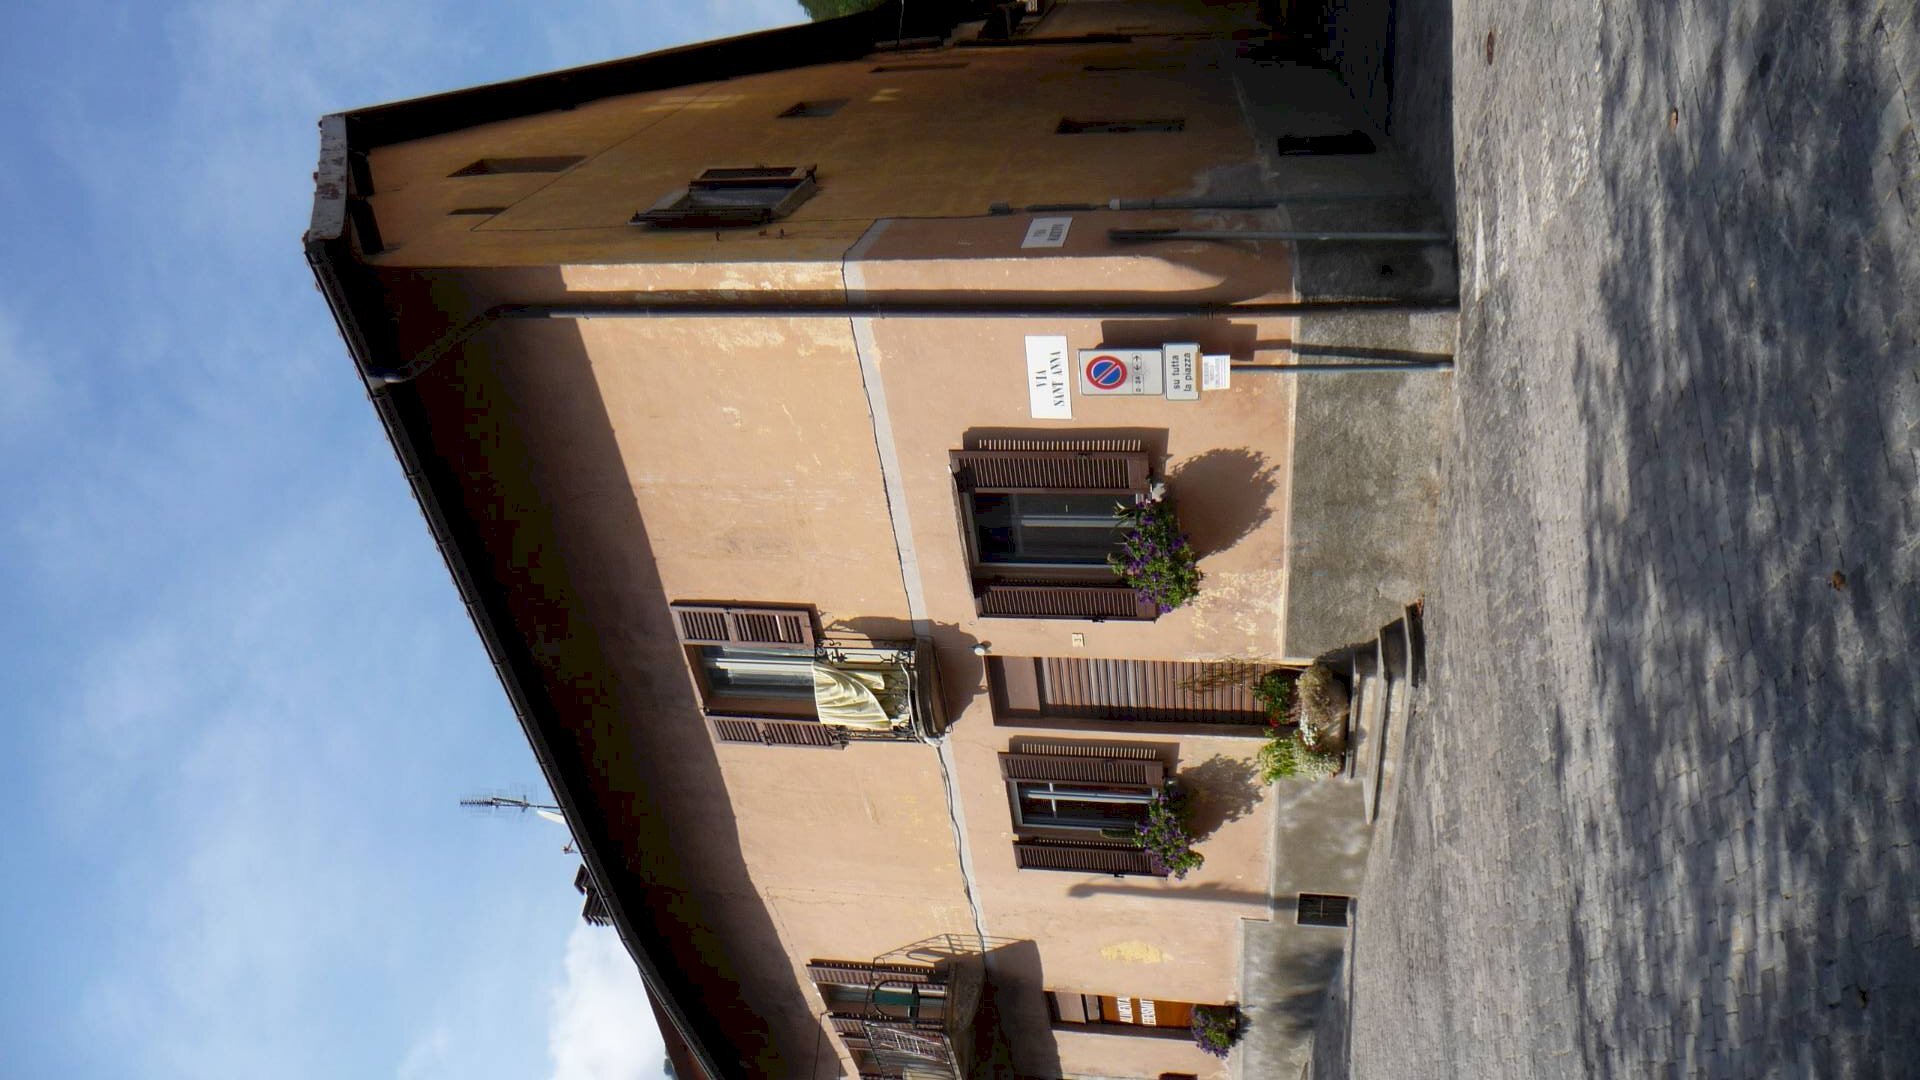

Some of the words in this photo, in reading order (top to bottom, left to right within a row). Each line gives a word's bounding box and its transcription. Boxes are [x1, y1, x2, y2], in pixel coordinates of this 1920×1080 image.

[1049, 351, 1063, 376] ANNA
[1171, 355, 1180, 376] tutta
[1183, 352, 1192, 381] piazza
[1035, 370, 1047, 388] VIA
[1172, 379, 1181, 390] su
[1183, 384, 1192, 392] la
